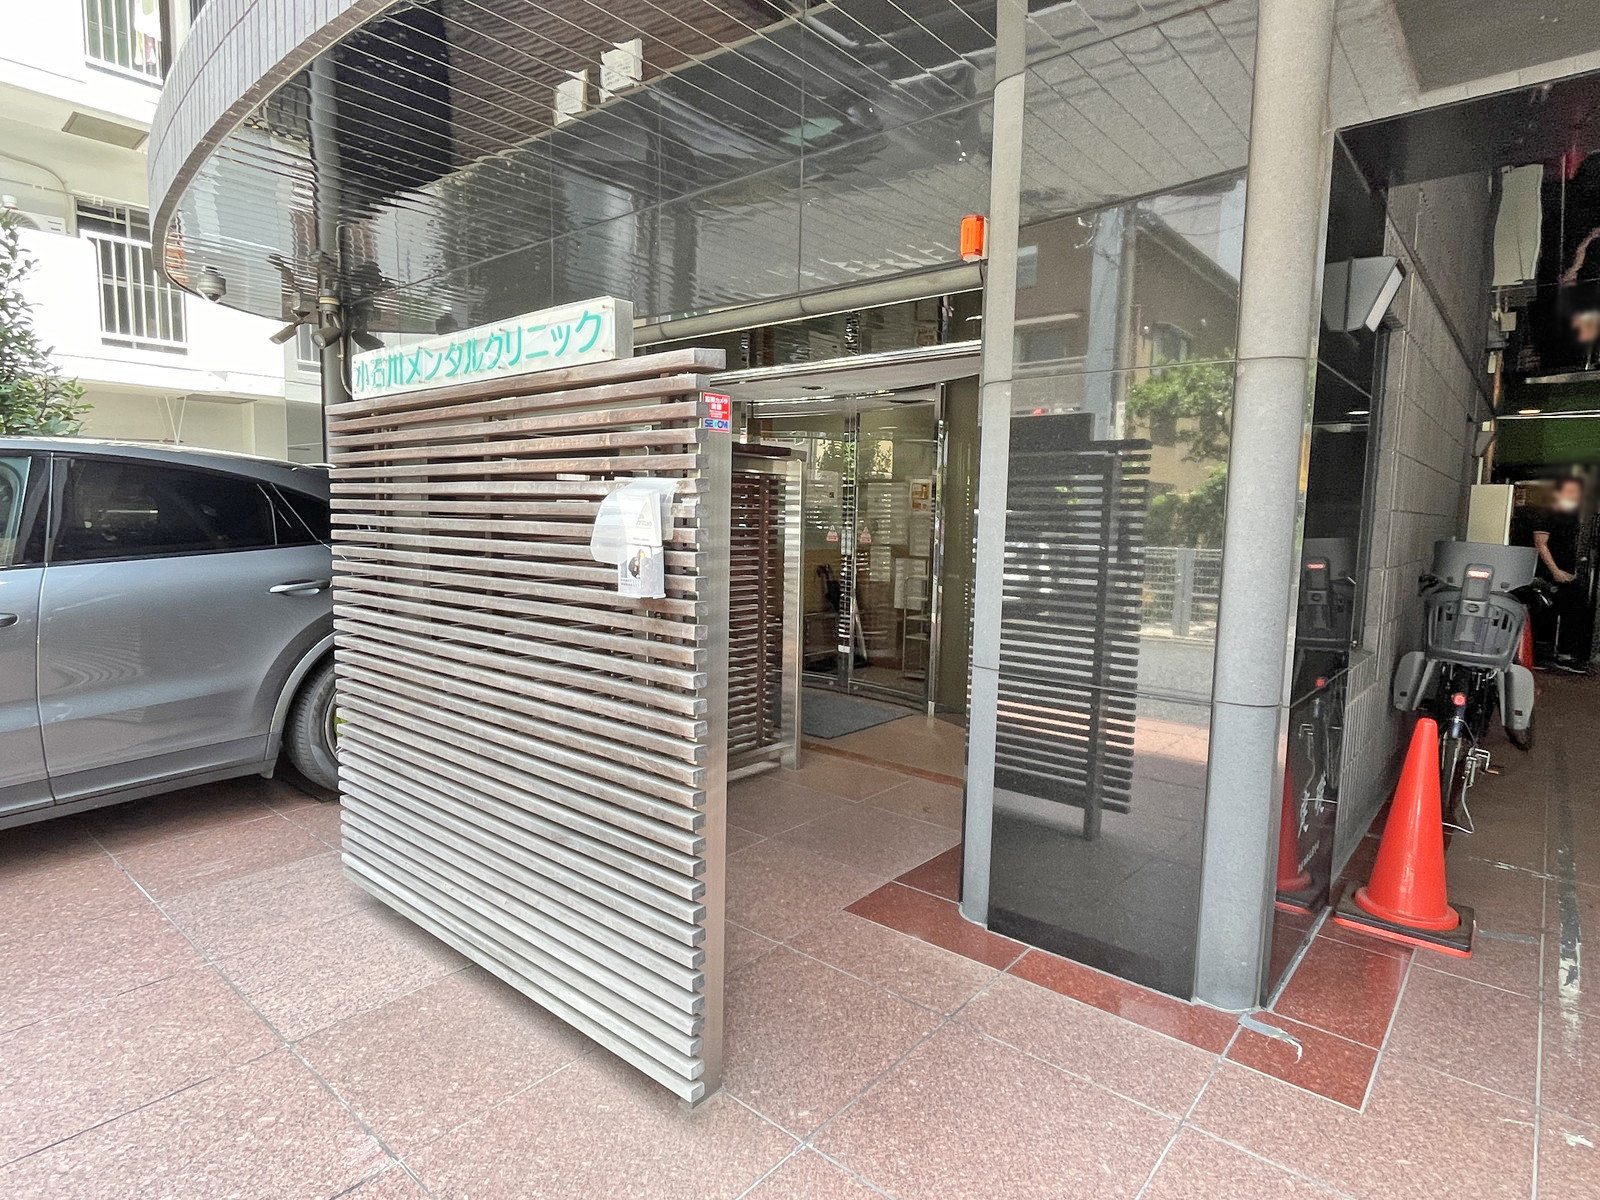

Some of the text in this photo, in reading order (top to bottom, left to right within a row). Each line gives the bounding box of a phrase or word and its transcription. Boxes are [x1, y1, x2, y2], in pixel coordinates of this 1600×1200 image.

[355, 310, 602, 392] 小石川メンタルクリニック
